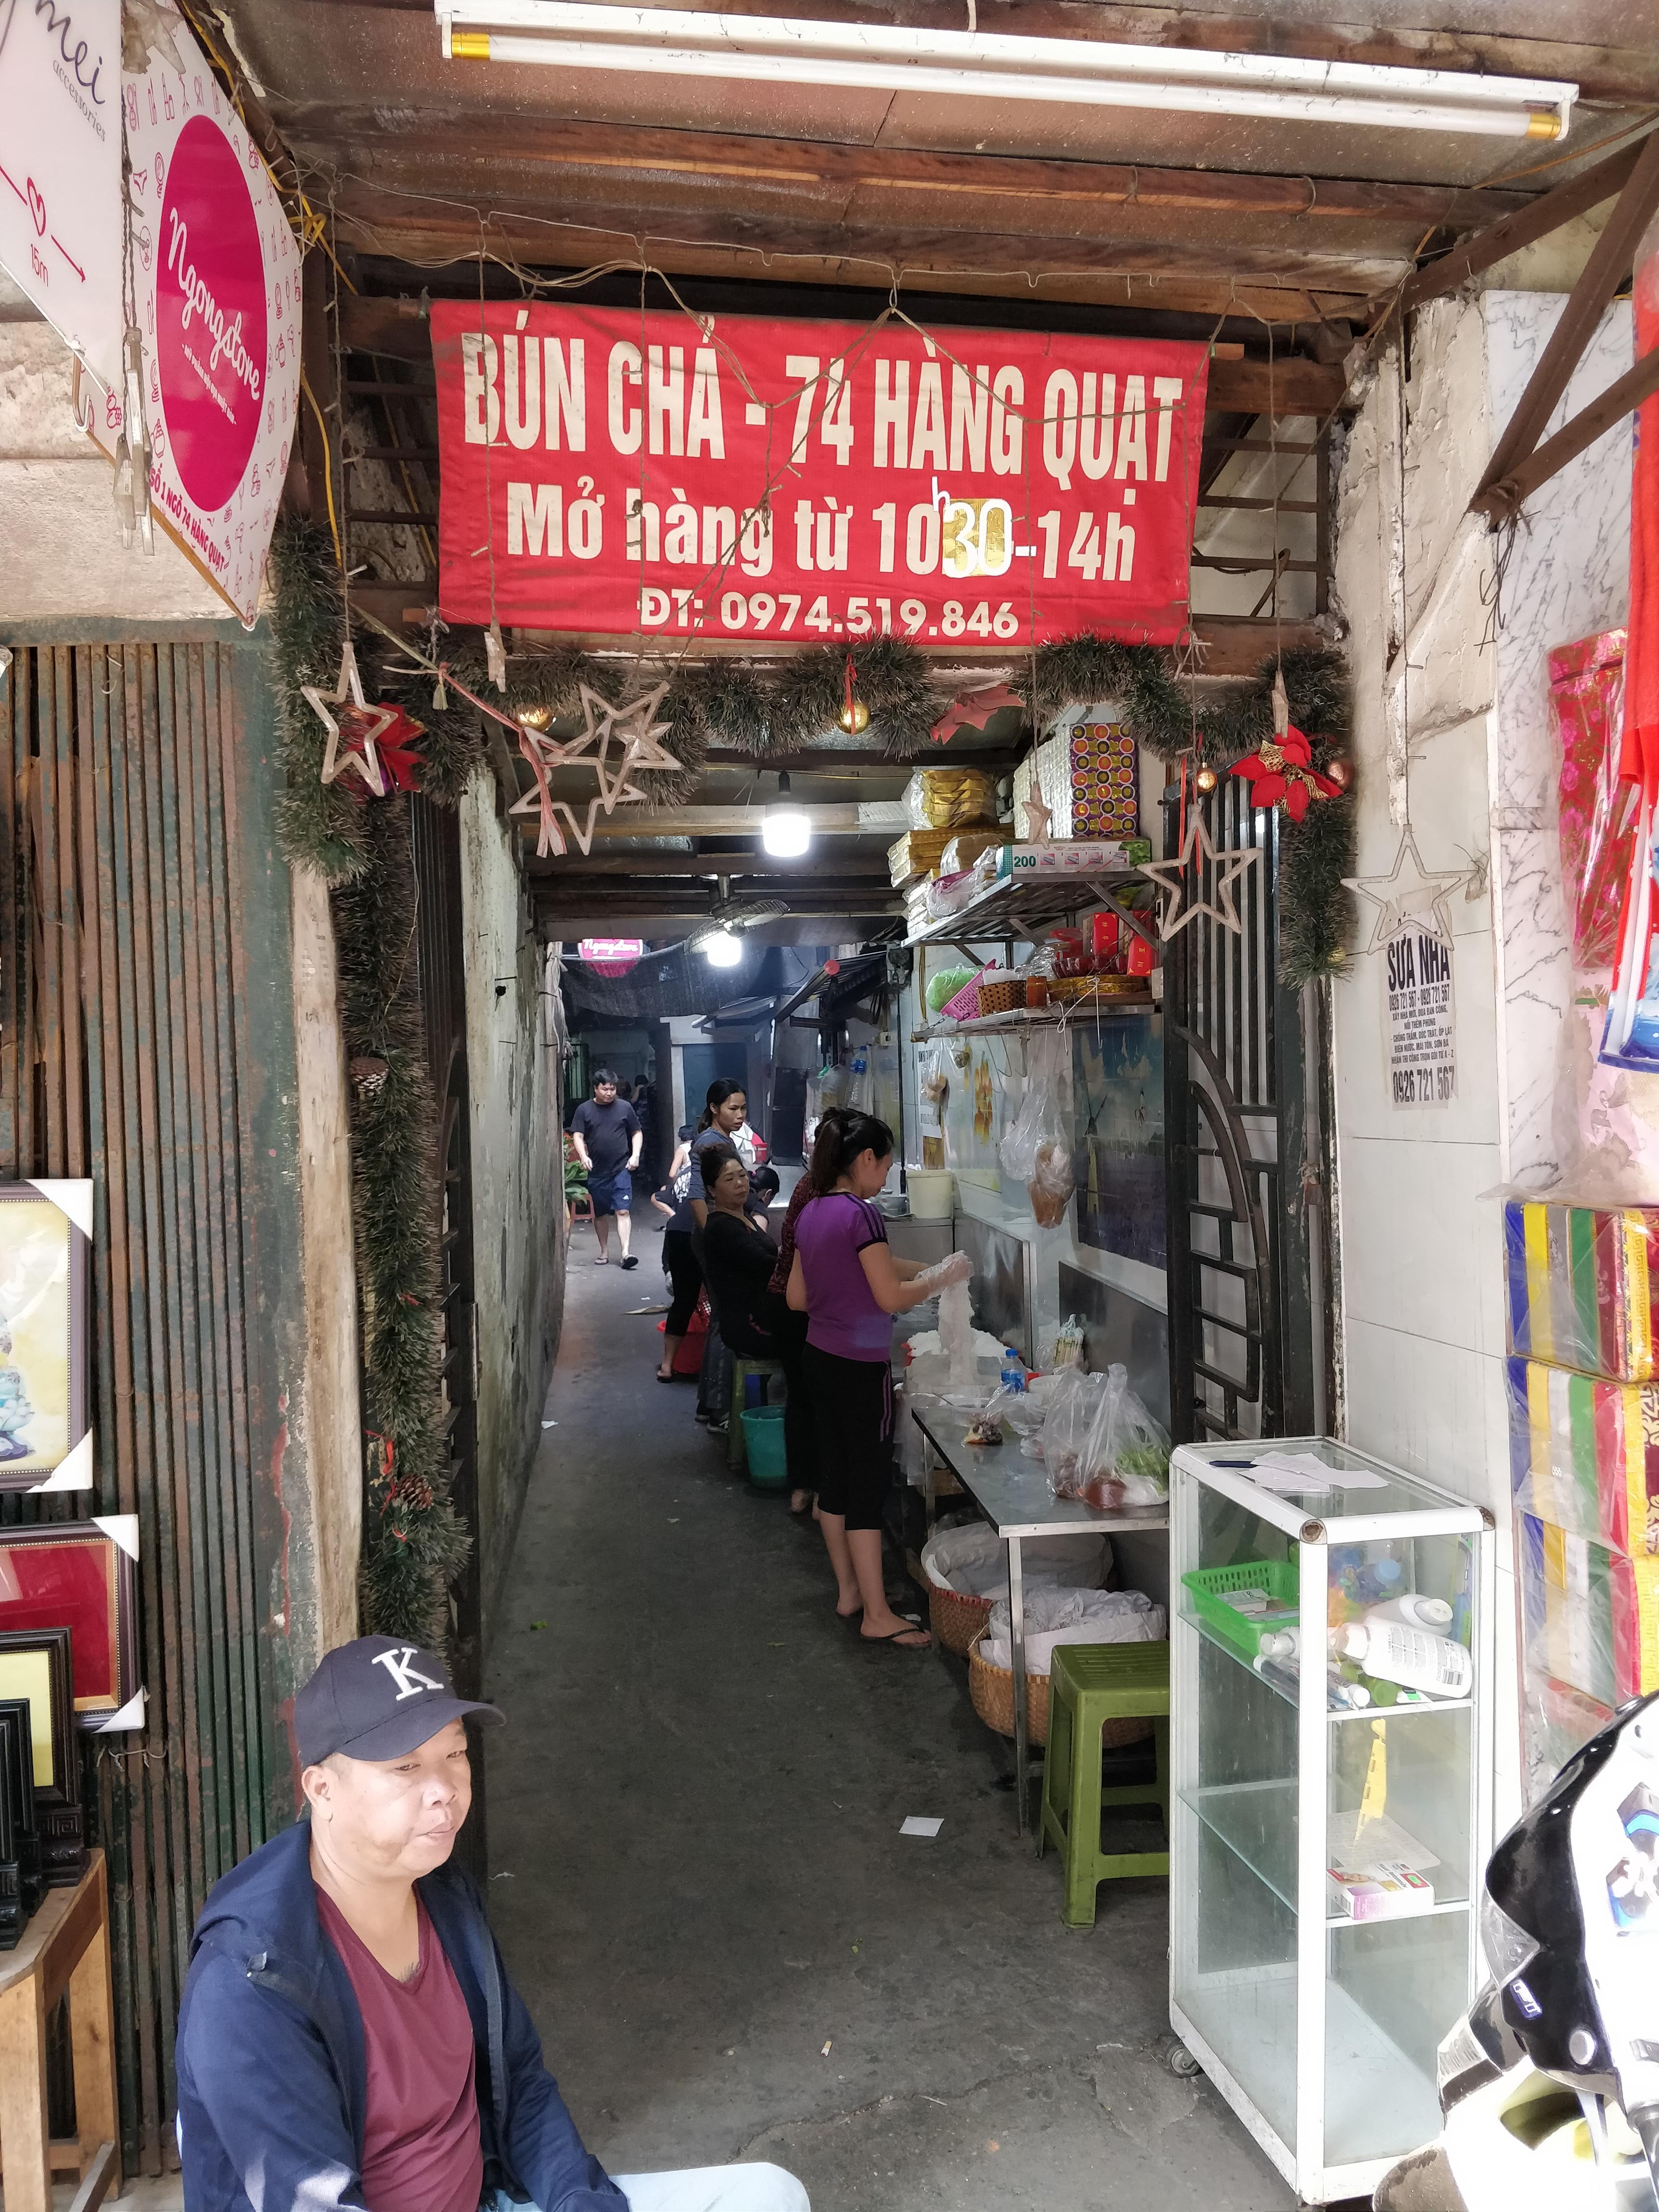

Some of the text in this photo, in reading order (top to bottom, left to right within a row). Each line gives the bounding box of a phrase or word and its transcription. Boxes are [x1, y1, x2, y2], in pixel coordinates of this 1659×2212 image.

[53, 60, 106, 142] accessories
[31, 244, 48, 287] 15m
[461, 311, 585, 452] BÚN
[608, 315, 726, 459] CHẢ
[786, 355, 854, 466] 74
[874, 338, 1024, 475] HÀNG
[1042, 369, 1183, 505] QUẠT
[150, 463, 163, 493] SỐ
[161, 481, 166, 501] 1
[182, 506, 191, 530] 74
[191, 518, 209, 552] HÀNG
[208, 541, 225, 572] QUẠT
[507, 476, 605, 560] Mở
[626, 488, 774, 577] hàng
[794, 496, 853, 571] từ
[637, 589, 1019, 638] ĐT: 0974.519.846
[1014, 856, 1036, 867] 200
[1388, 933, 1416, 992] SỬA
[1389, 994, 1399, 1011] 0926
[1421, 987, 1431, 1006] 0926
[1431, 986, 1440, 1004] 721
[1441, 983, 1450, 1002] 567
[1439, 1025, 1444, 1036] ỐP
[1444, 1050, 1448, 1058] A
[1451, 1049, 1454, 1058] Z
[1393, 1066, 1455, 1103] 0926 721 567
[371, 1647, 445, 1701] K
